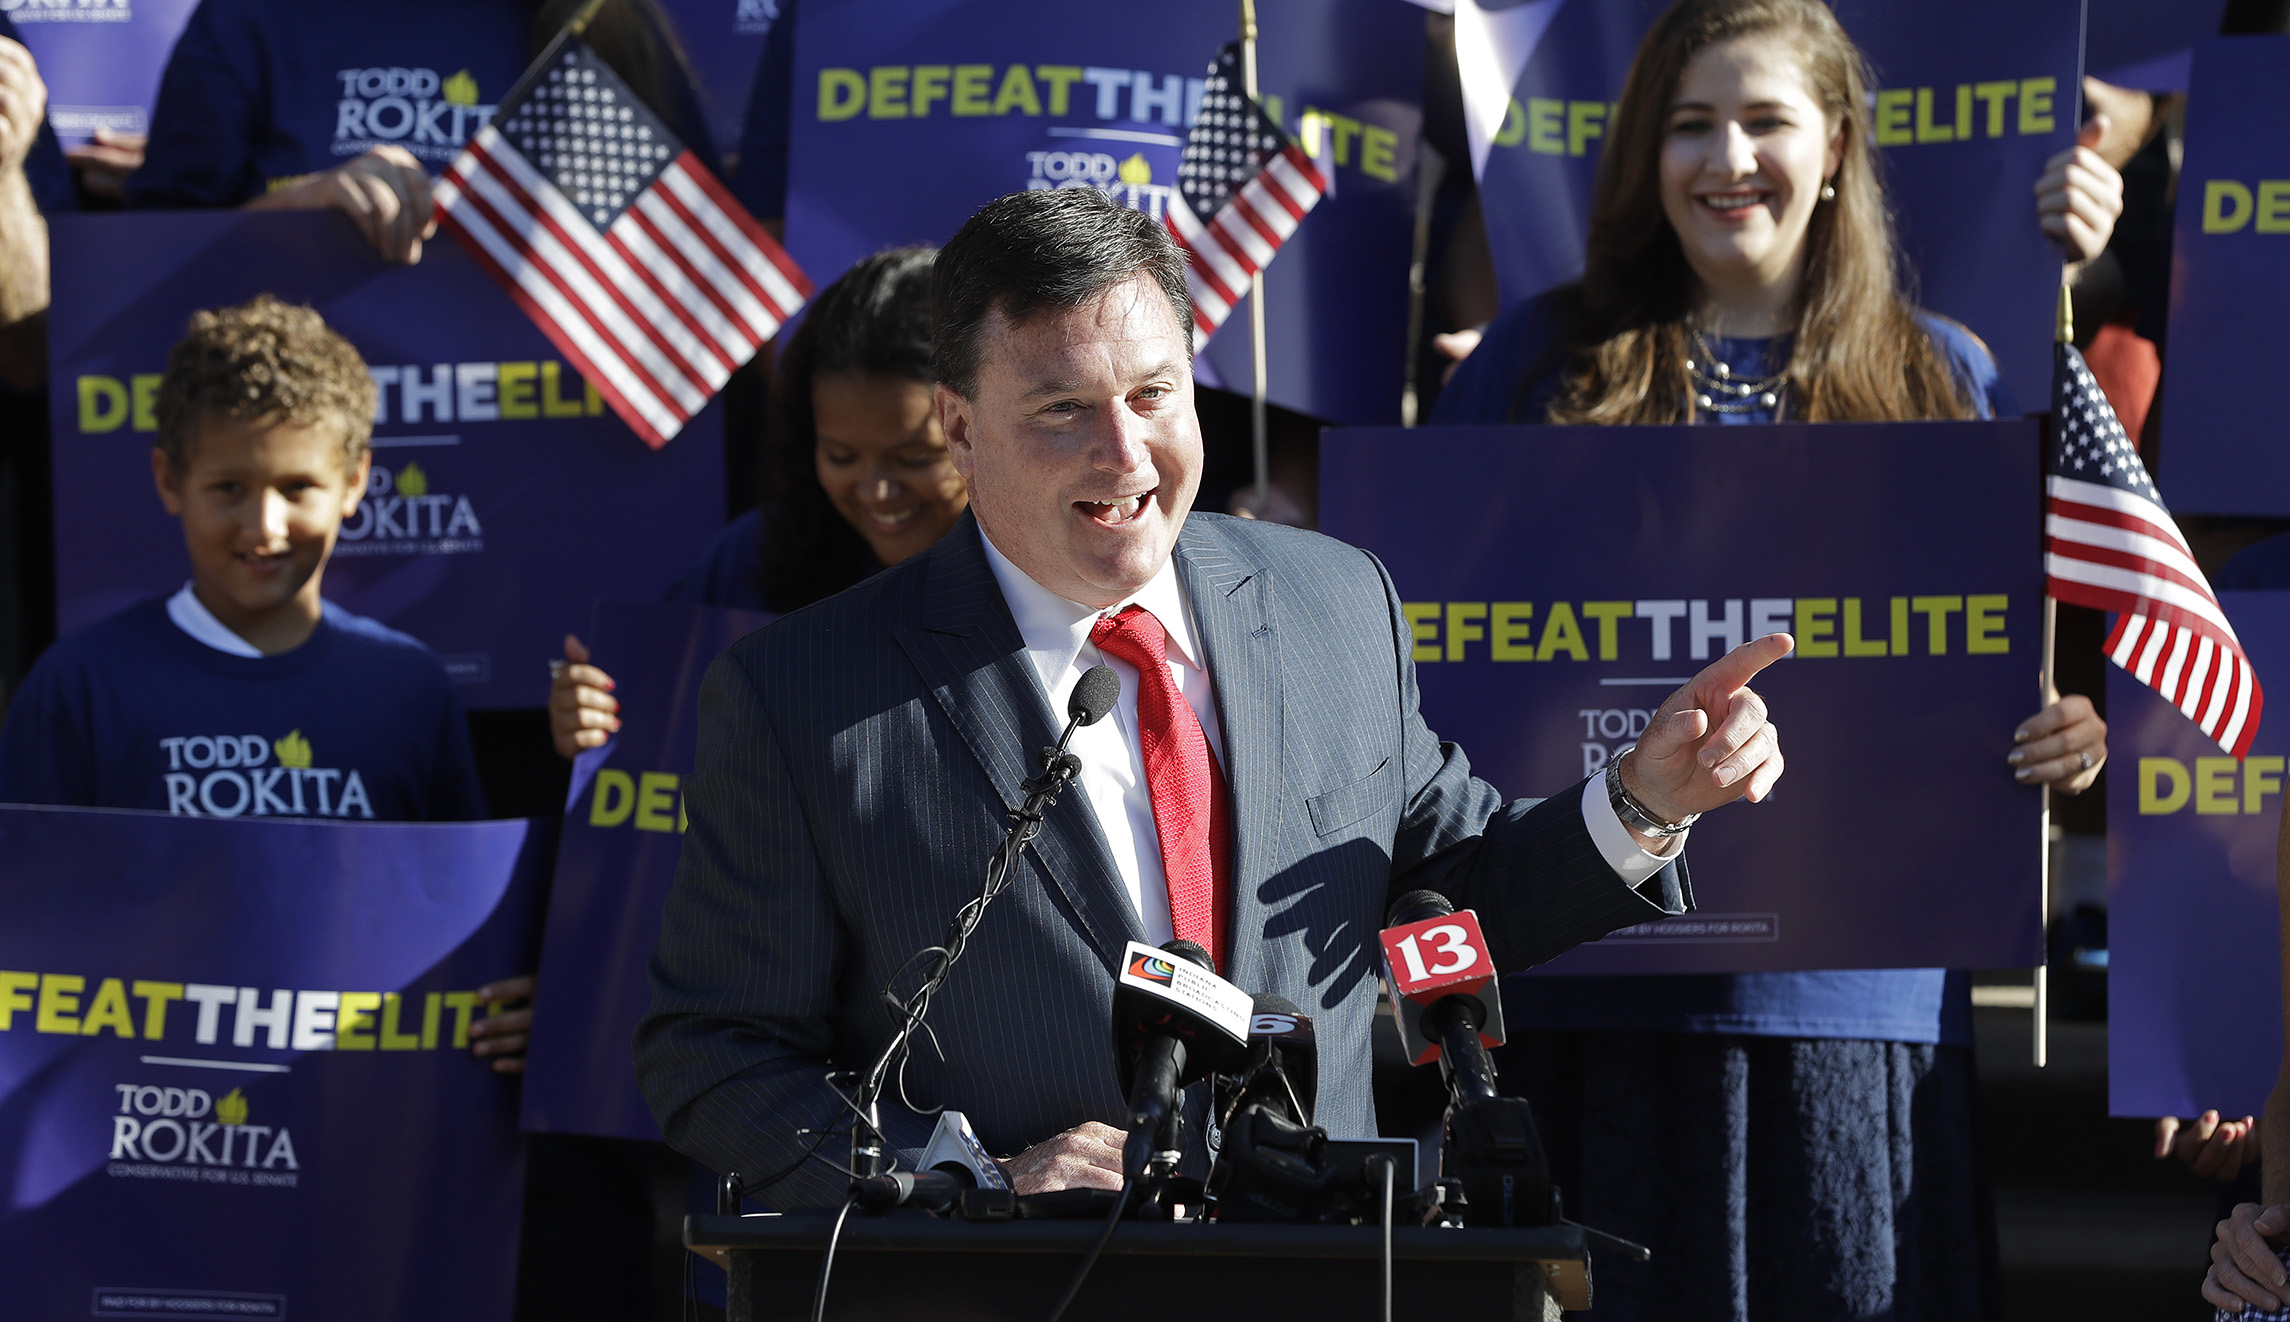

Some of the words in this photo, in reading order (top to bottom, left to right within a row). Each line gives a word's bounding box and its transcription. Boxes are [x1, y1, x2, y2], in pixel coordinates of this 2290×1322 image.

[336, 67, 440, 99] TODD
[334, 95, 500, 146] ROKIT
[1493, 96, 1619, 157] DEF
[1025, 151, 1117, 181] TODD
[339, 492, 483, 541] OKITA
[1402, 601, 1633, 663] EFEAT
[1578, 708, 1658, 739] TOD
[159, 734, 270, 770] TODD
[163, 767, 375, 819] ROKITA
[589, 768, 688, 834] DE
[1395, 924, 1478, 983] 13
[1177, 973, 1211, 992] PUBLIC
[1179, 967, 1217, 989] INDIANA
[1175, 987, 1217, 1012] STATIONS
[1176, 980, 1245, 1022] BROADCASTING
[115, 1083, 212, 1118] TODD
[108, 1115, 299, 1170] ROKITA
